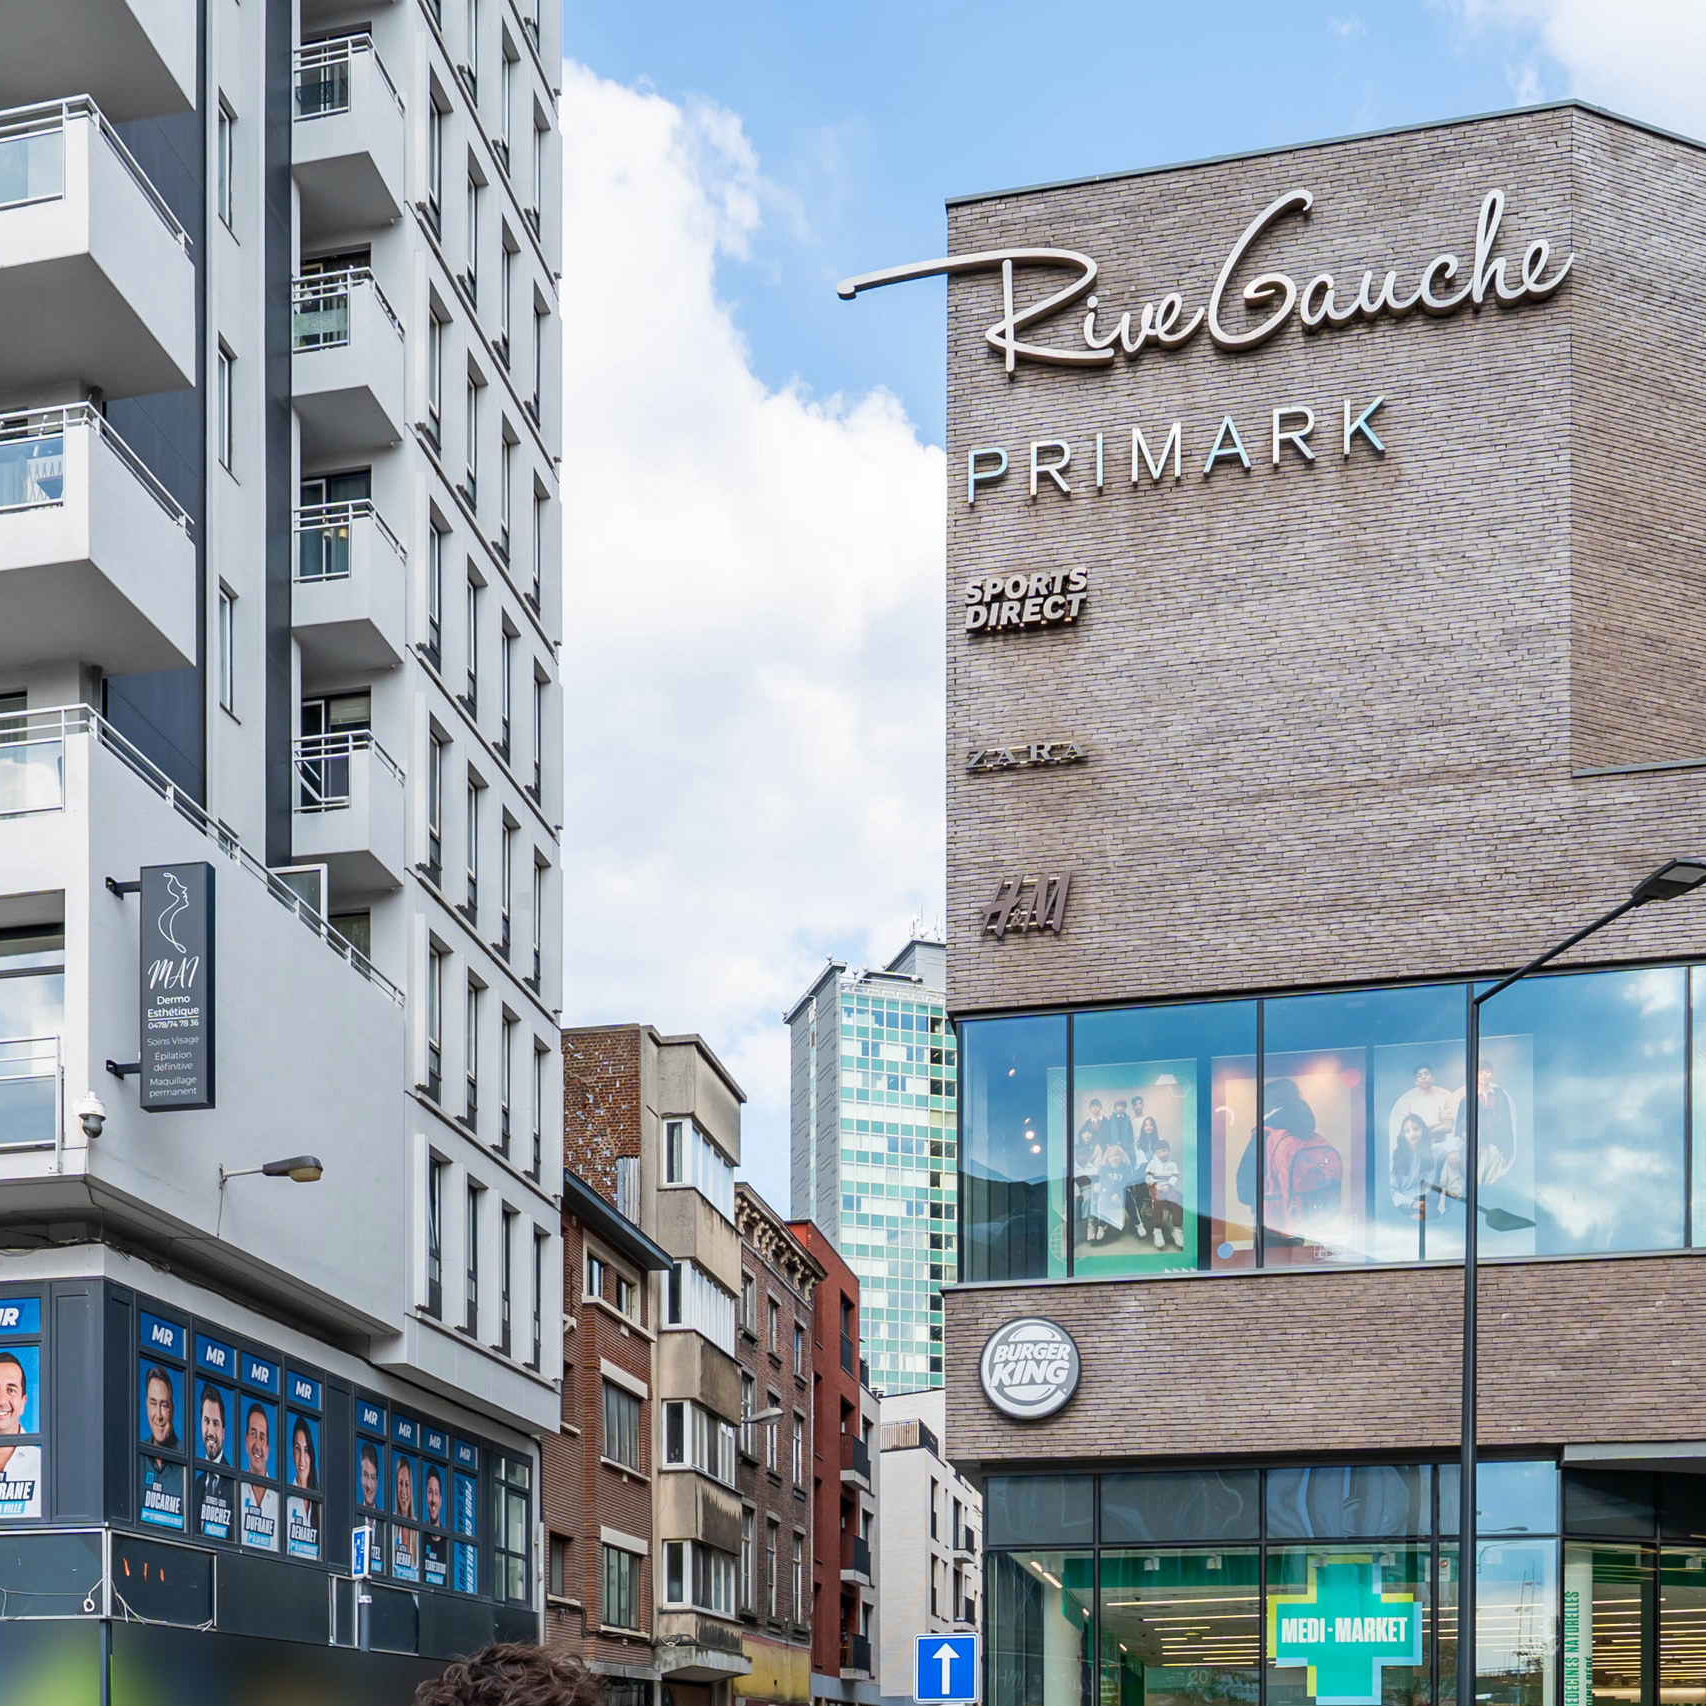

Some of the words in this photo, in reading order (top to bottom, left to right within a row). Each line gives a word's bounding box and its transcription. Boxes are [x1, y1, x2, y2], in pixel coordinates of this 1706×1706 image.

[837, 247, 1205, 374] Rive
[1207, 189, 1575, 351] Gauche
[966, 395, 1387, 504] PRIMARK
[964, 566, 1088, 604] SPORTS
[965, 592, 1087, 629] DIRECT
[966, 740, 1088, 769] ZARA
[979, 869, 1072, 938] H&M
[157, 994, 191, 1006] Dermo
[147, 1005, 200, 1019] Esthétique
[148, 1019, 177, 1030] 0478/74
[179, 1019, 189, 1028] 78
[190, 1018, 200, 1028] 36
[147, 1036, 170, 1047] Soins
[172, 1034, 200, 1047] Visage
[153, 1061, 193, 1072] définitive
[150, 1075, 197, 1089] Maquillage
[149, 1086, 197, 1099] permanent
[151, 1324, 174, 1347] MR
[205, 1345, 226, 1367] MR
[993, 1343, 1071, 1363] BURGER
[251, 1363, 270, 1383] MR
[991, 1360, 1071, 1387] KING
[295, 1380, 312, 1400] MR
[363, 1408, 378, 1426] MR
[398, 1421, 412, 1439] MR
[428, 1433, 442, 1449] MR
[459, 1446, 472, 1462] MR
[145, 1490, 181, 1514] DUCARME
[200, 1504, 232, 1526] BOUCHEZ
[1565, 1590, 1579, 1653] NATURELLES
